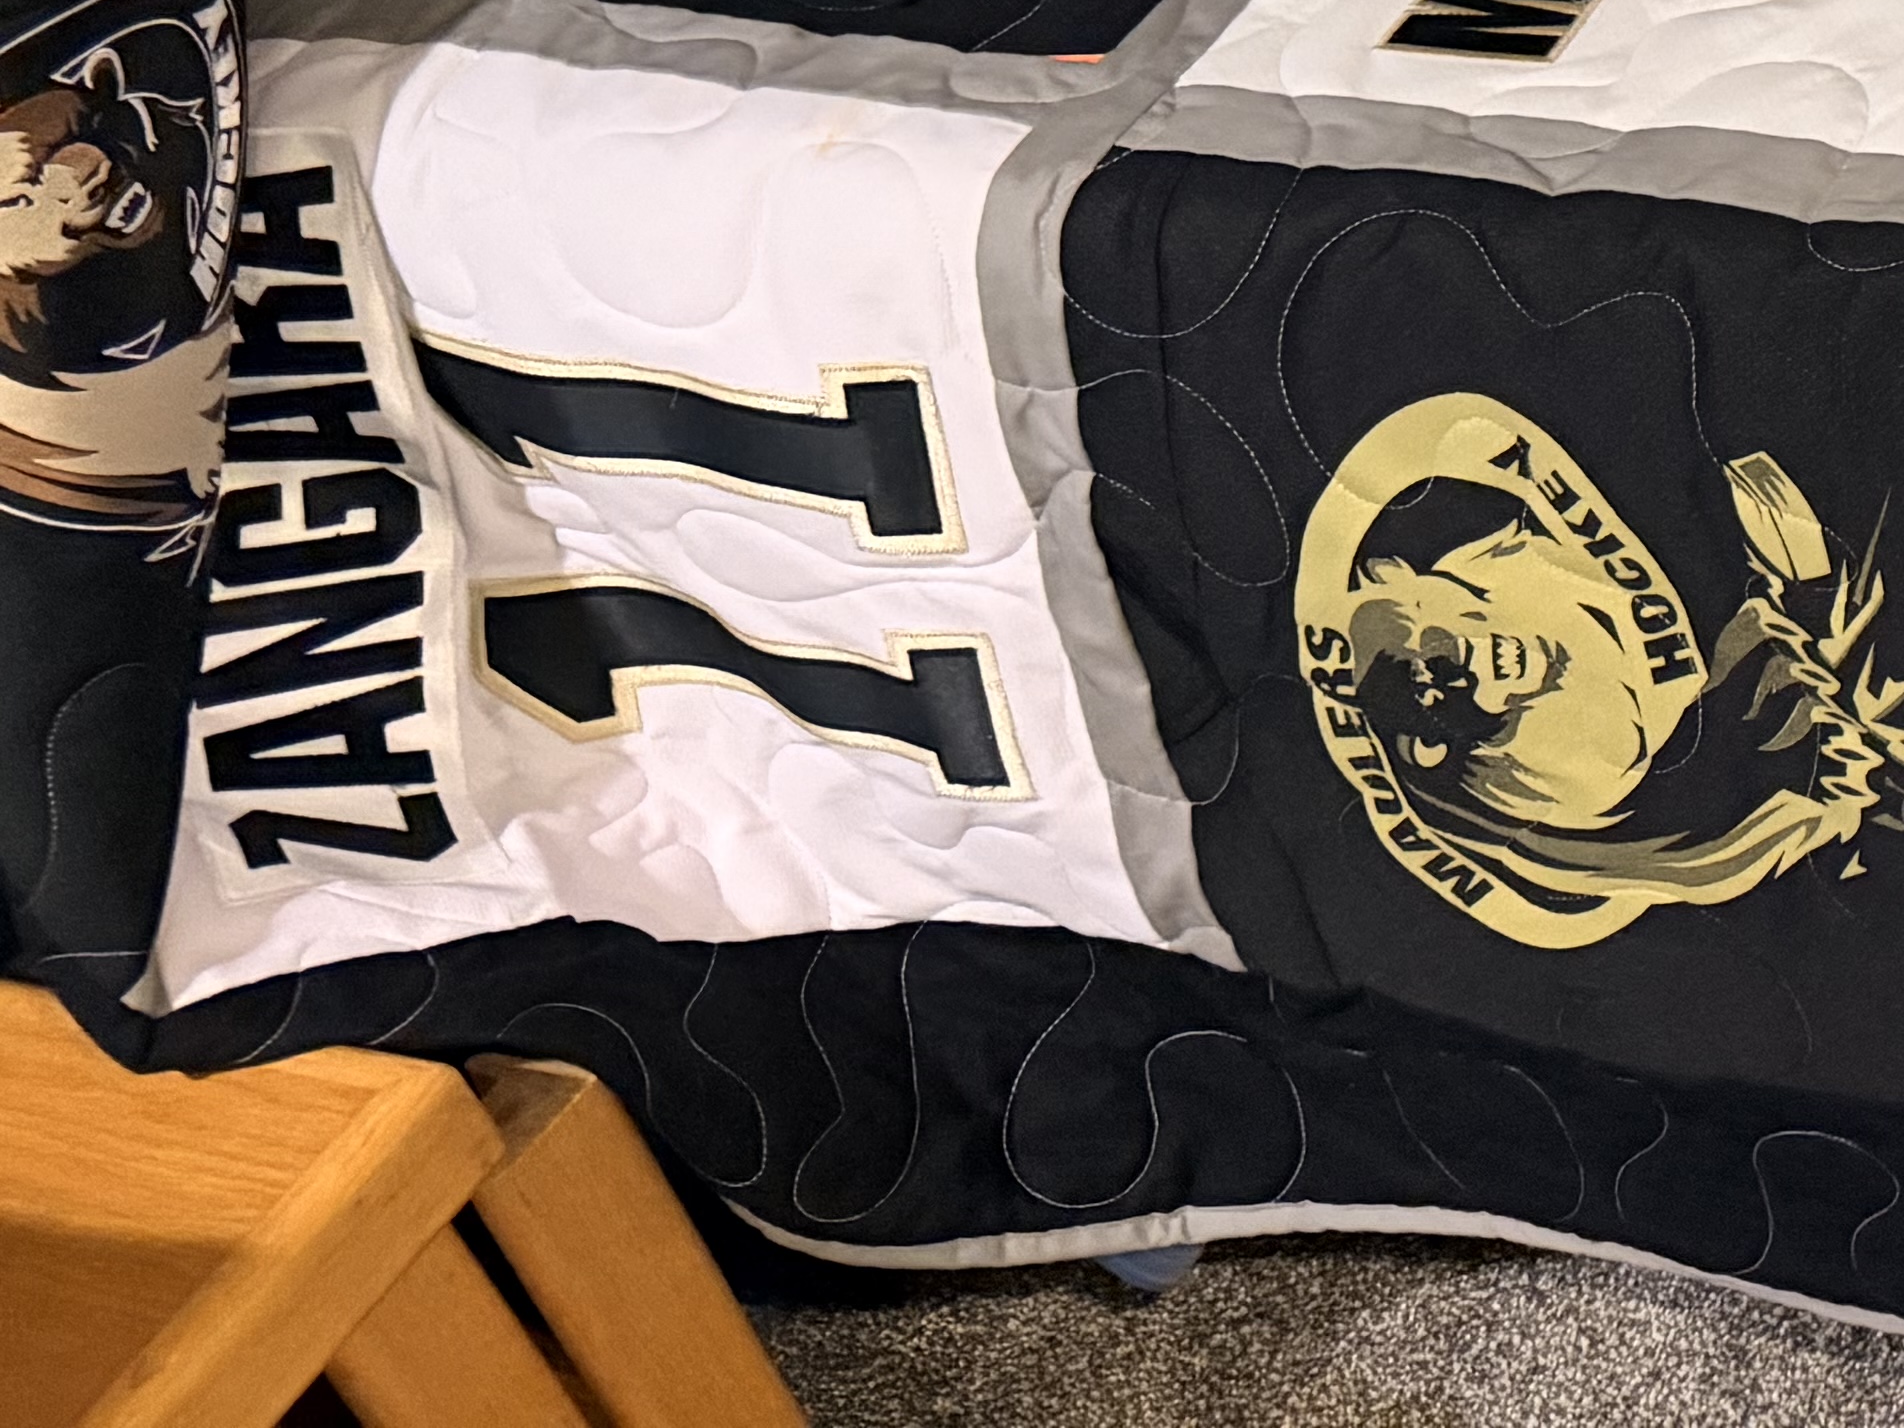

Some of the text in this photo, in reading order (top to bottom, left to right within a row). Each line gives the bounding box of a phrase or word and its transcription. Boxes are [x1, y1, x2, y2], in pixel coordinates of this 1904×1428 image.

[410, 329, 1040, 804] 11
[1488, 434, 1706, 686] HOCKEY
[1304, 622, 1495, 909] MAULERS
